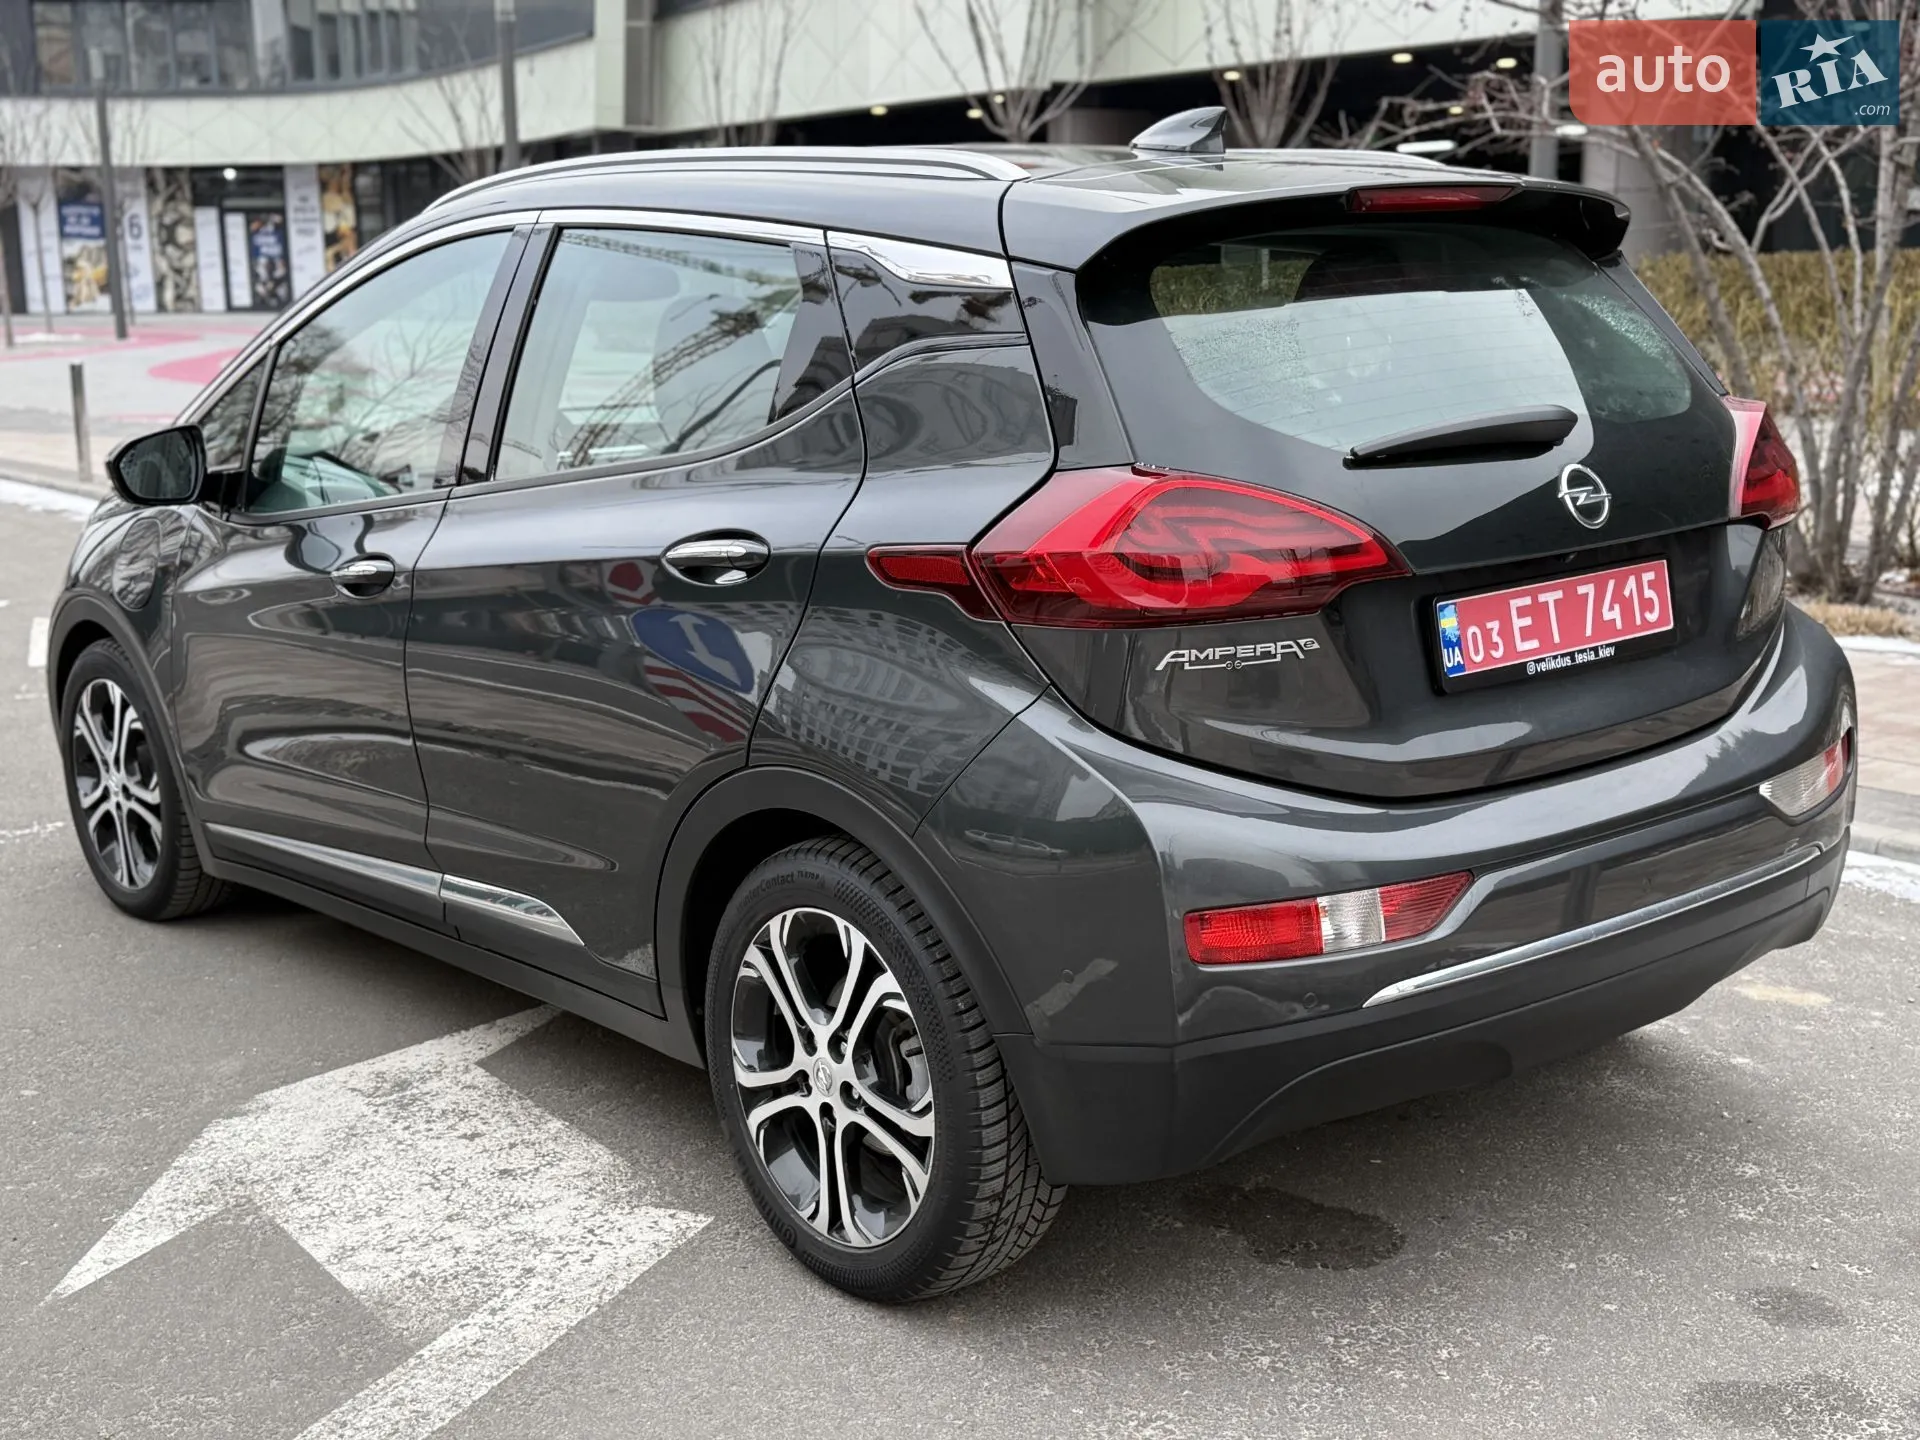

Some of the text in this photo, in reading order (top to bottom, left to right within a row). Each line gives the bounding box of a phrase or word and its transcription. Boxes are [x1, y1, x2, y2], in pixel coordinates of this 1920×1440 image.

[1444, 571, 1660, 668] UA 03 ET 7415
[1526, 645, 1616, 675] @velikdus_tesla_kiev
